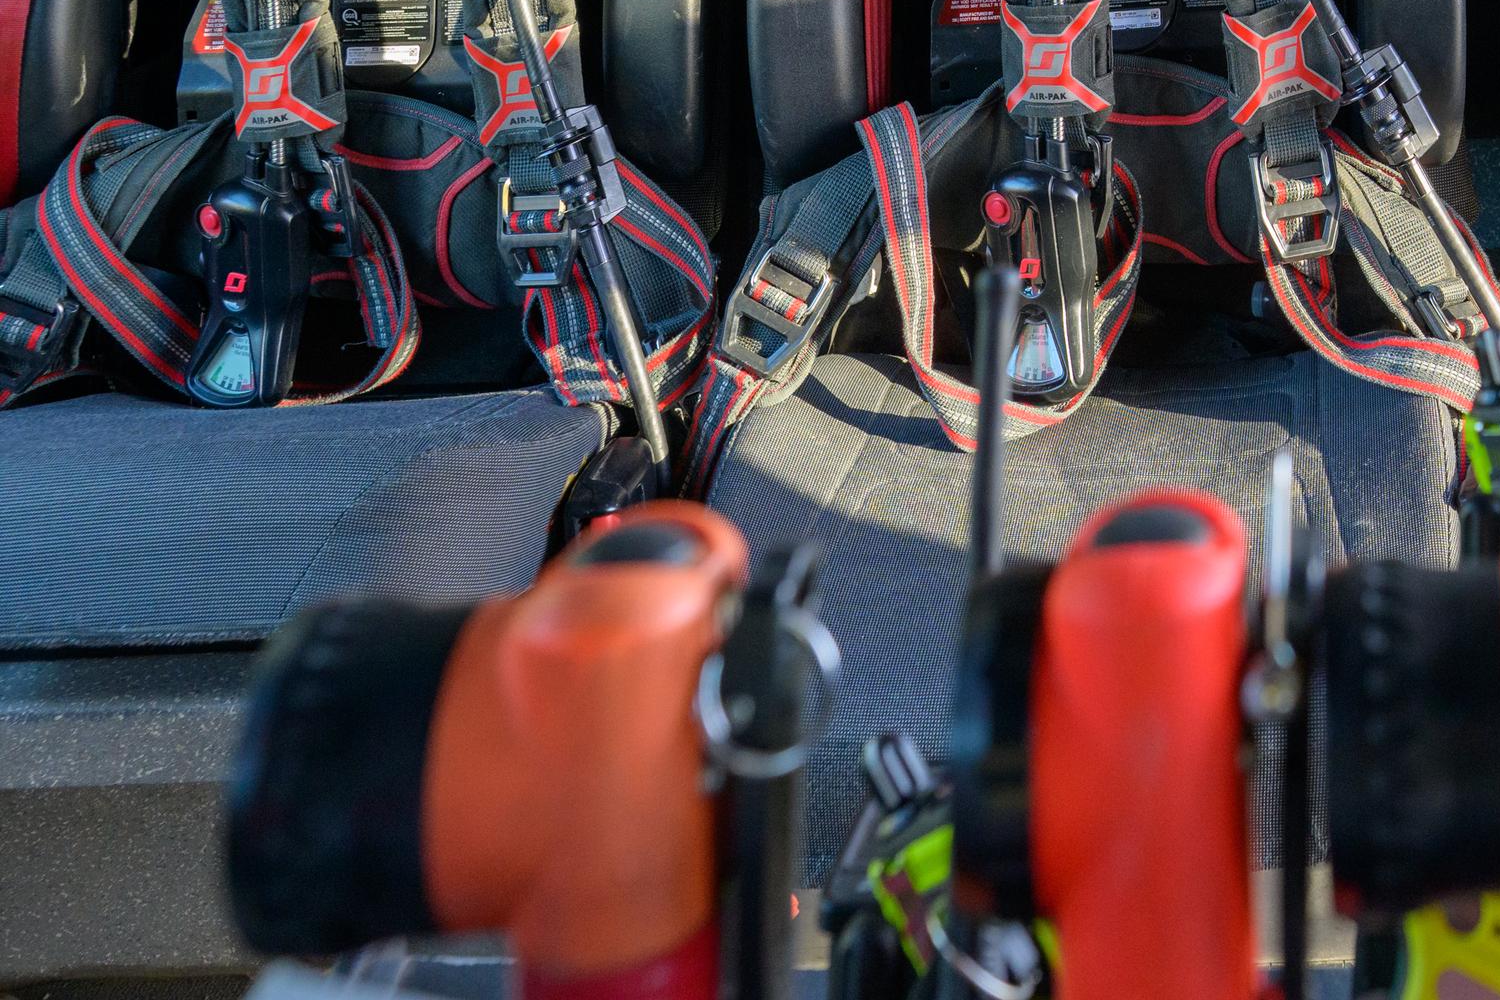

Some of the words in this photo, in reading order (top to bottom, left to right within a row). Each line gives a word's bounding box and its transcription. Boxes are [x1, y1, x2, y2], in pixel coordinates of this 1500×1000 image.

[1029, 92, 1067, 101] AIR-PAK
[1267, 82, 1304, 101] AIR-PAK
[252, 113, 288, 124] AIR-PAK
[510, 114, 541, 125] AIR-PA
